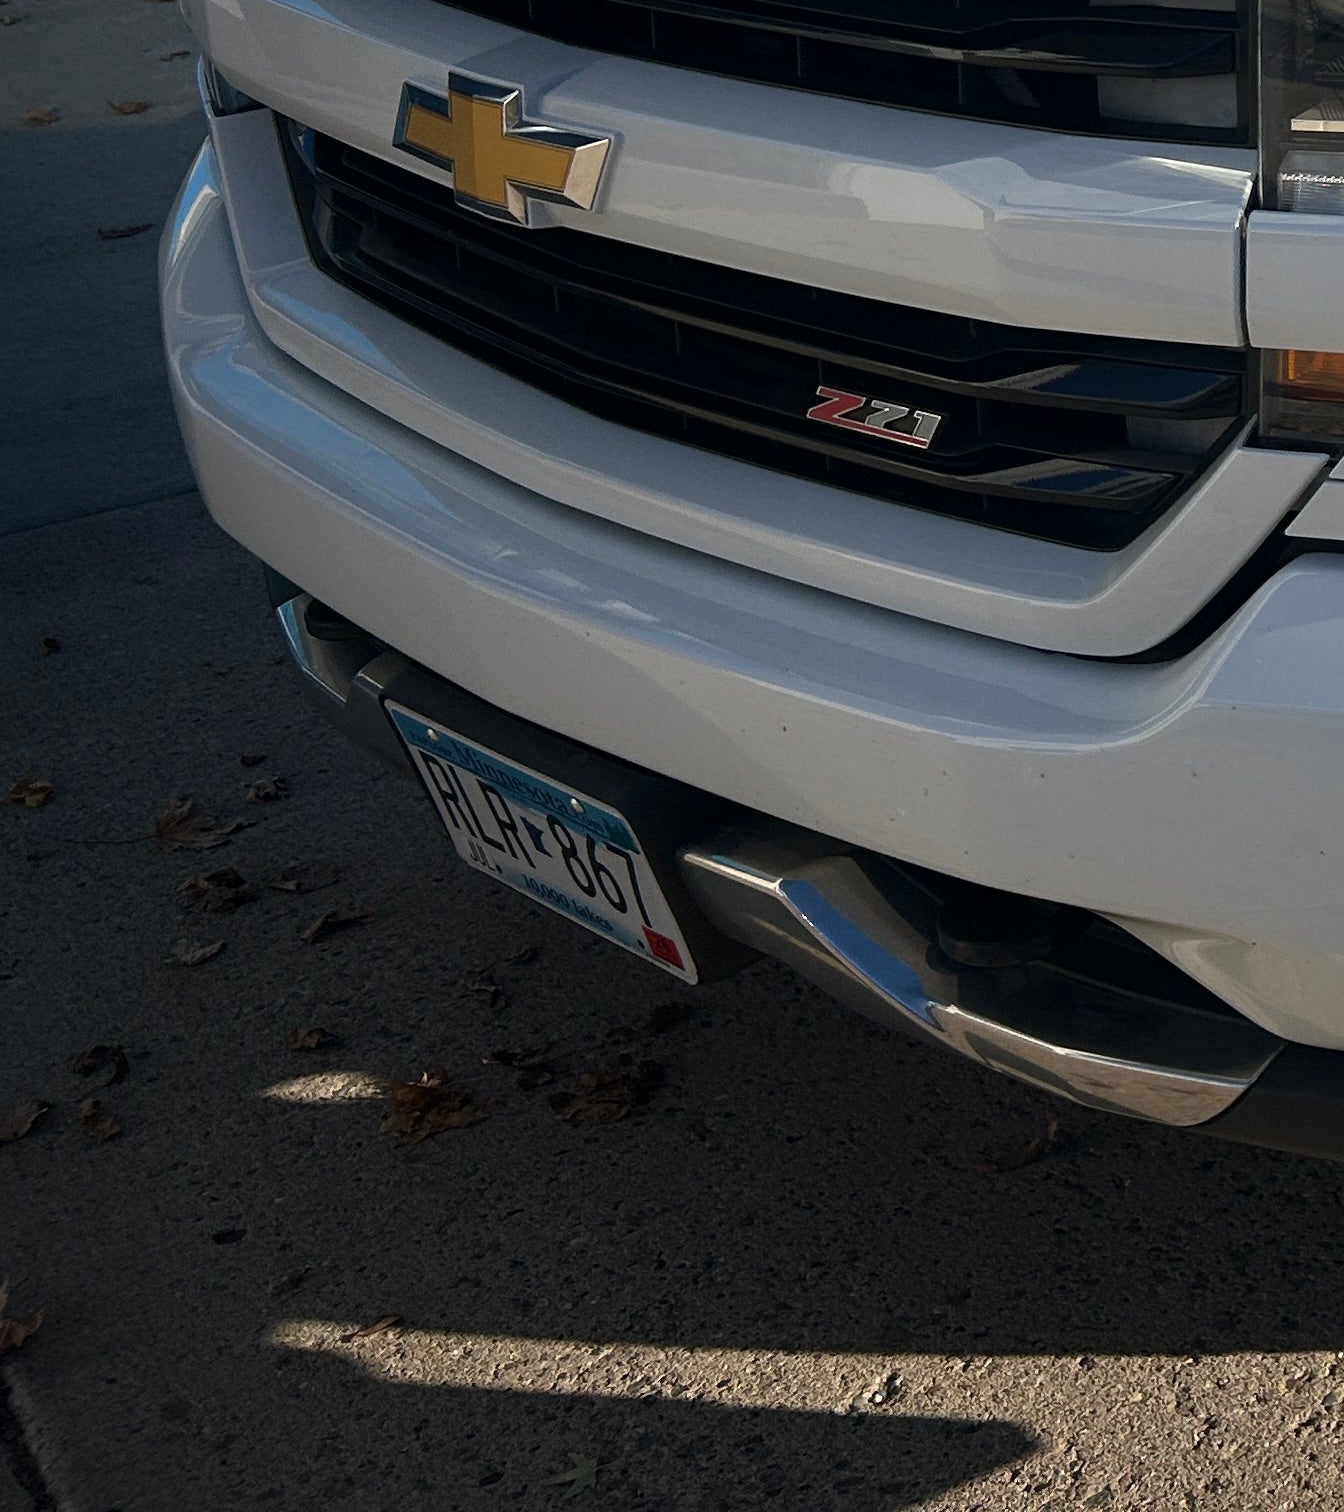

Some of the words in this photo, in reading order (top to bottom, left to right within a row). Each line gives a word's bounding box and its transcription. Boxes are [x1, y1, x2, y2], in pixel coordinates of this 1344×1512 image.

[806, 385, 942, 449] Z71
[450, 739, 569, 817] Minnesota
[418, 750, 537, 869] RLR
[546, 814, 653, 928] 867
[469, 840, 496, 873] JUL
[572, 898, 615, 932] lakes
